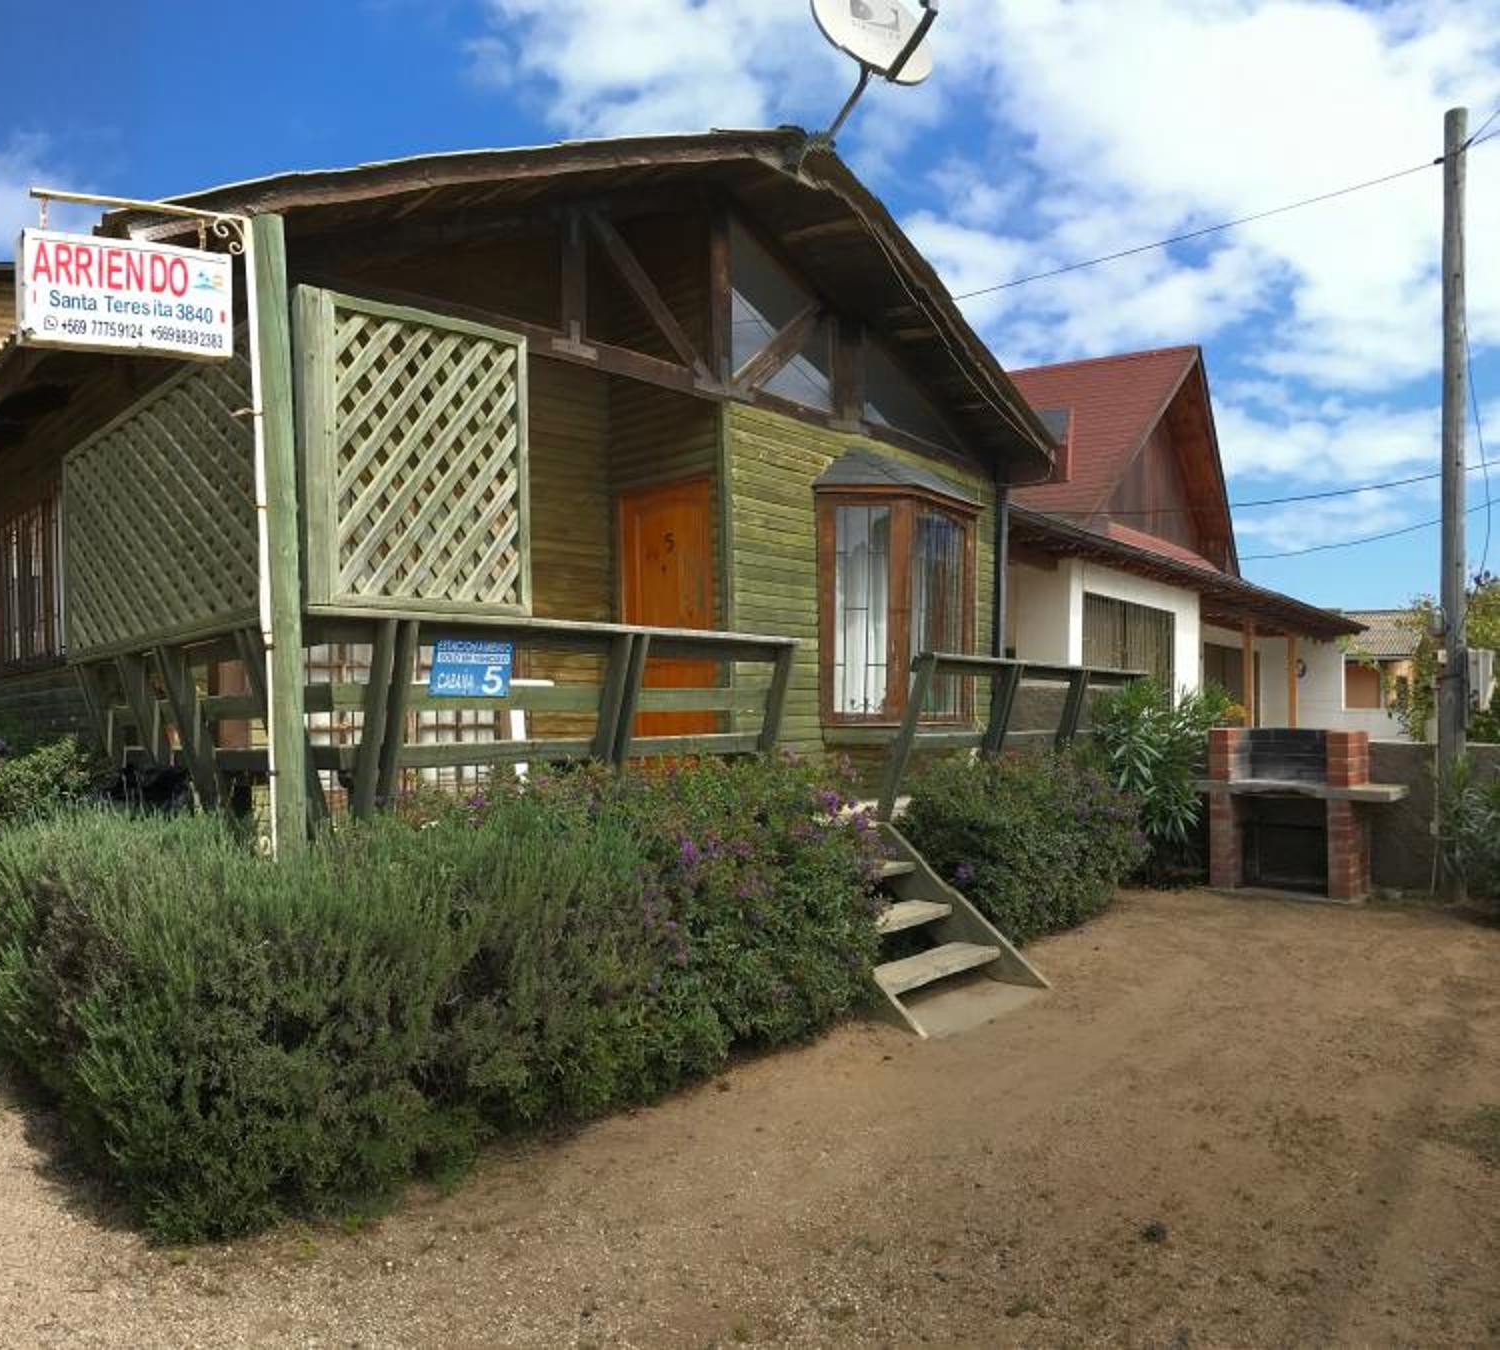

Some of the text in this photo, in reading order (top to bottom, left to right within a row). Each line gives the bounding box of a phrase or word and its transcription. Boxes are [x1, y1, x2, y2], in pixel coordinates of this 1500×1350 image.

[32, 239, 188, 296] ARRIENDO
[49, 289, 213, 325] Santa Teresita 3840
[481, 665, 503, 694] 5
